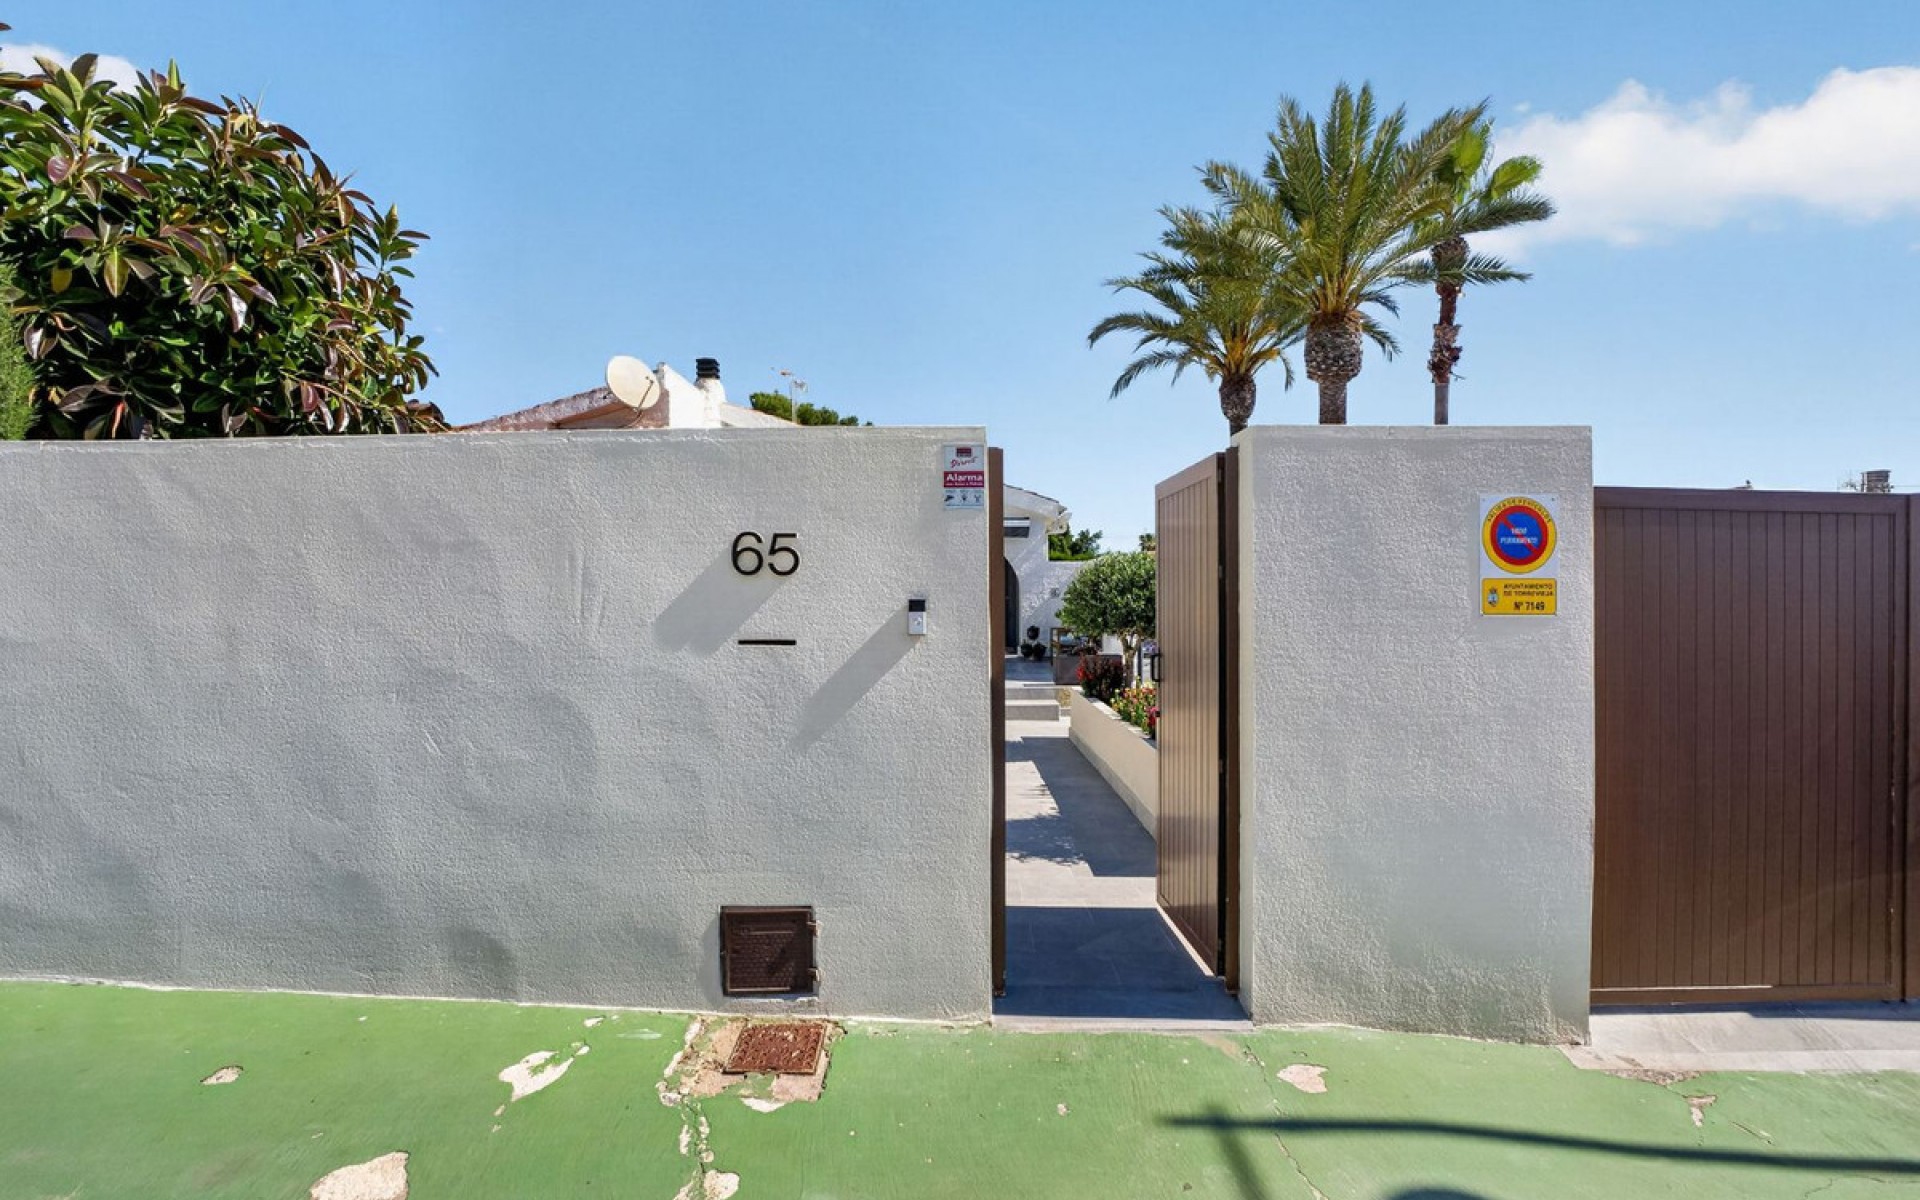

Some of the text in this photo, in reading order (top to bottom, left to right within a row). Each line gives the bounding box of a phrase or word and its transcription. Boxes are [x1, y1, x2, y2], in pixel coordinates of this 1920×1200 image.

[946, 473, 983, 481] Alarma
[731, 531, 800, 576] 65
[1525, 601, 1545, 611] 7149
